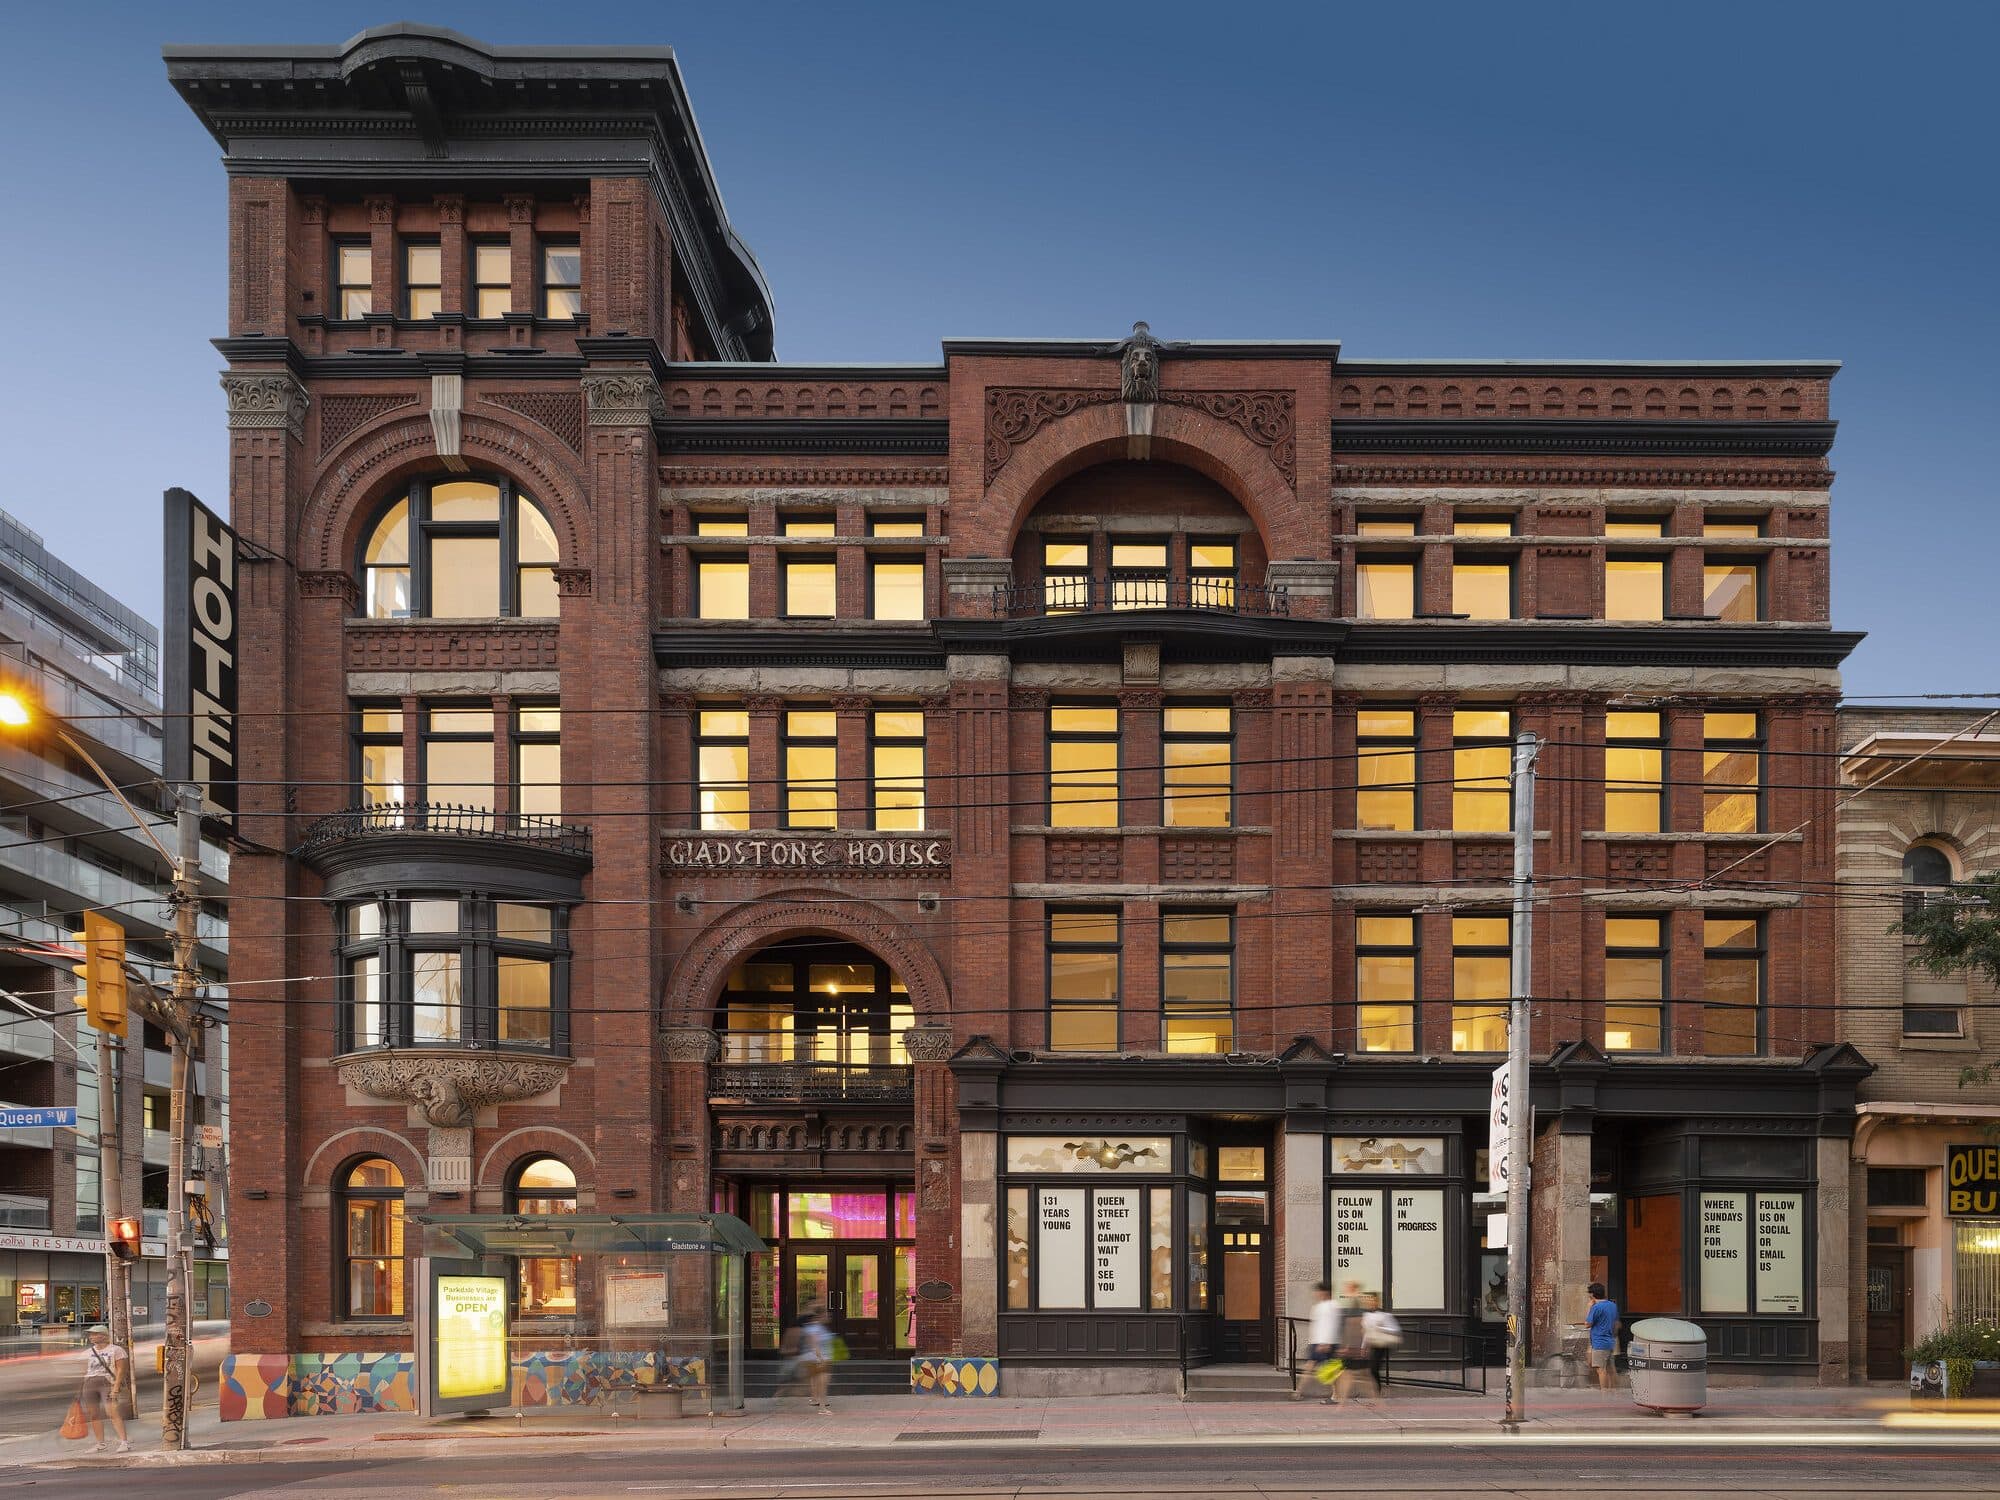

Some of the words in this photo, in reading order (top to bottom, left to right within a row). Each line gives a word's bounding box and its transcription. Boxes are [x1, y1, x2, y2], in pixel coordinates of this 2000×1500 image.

[193, 506, 233, 826] HOTEL
[670, 841, 829, 866] GLADSTONE
[848, 841, 944, 866] HOUSE
[0, 1111, 42, 1126] Queen
[47, 1110, 55, 1118] St
[56, 1110, 68, 1123] W
[1950, 1148, 2000, 1187] QUE
[1043, 1196, 1058, 1206] 131
[1097, 1196, 1125, 1207] QUEEN
[1337, 1197, 1373, 1207] FOLLOW
[1397, 1197, 1413, 1207] ART
[1704, 1200, 1734, 1210] WHERE
[1759, 1200, 1795, 1210] FOLLOW
[1950, 1190, 2000, 1213] BU
[1043, 1208, 1070, 1218] YEARS
[1097, 1208, 1130, 1218] STREET
[1337, 1209, 1349, 1219] US
[1351, 1209, 1363, 1219] ON
[1397, 1210, 1407, 1219] IN
[1704, 1212, 1743, 1222] SUNDAYS
[1759, 1213, 1771, 1222] US
[1774, 1213, 1786, 1222] ON
[1043, 1220, 1071, 1230] YOUNG
[1097, 1221, 1111, 1230] WE
[1337, 1222, 1368, 1231] SOCIAL
[1397, 1222, 1437, 1231] PROGRESS
[1704, 1225, 1721, 1234] ARE
[1759, 1225, 1791, 1235] SOCIAL
[1097, 1233, 1131, 1243] CANNOT
[1337, 1234, 1349, 1243] OR
[1704, 1237, 1721, 1246] FOR
[1759, 1238, 1772, 1247] OR
[32, 1238, 106, 1251] RESTAUR
[671, 1242, 699, 1251] Gladstone
[1097, 1245, 1120, 1255] WAIT
[1337, 1246, 1363, 1256] EMAIL
[1704, 1249, 1738, 1259] QUEENS
[1759, 1250, 1786, 1259] EMAIL
[1097, 1258, 1109, 1267] TO
[1337, 1258, 1350, 1268] US
[1759, 1262, 1772, 1272] US
[1097, 1270, 1114, 1279] SEE
[443, 1286, 475, 1294] Parkdale
[1097, 1282, 1115, 1292] YOU
[455, 1303, 488, 1313] OPEN
[1634, 1359, 1647, 1368] Litter
[1662, 1361, 1680, 1370] Litter
